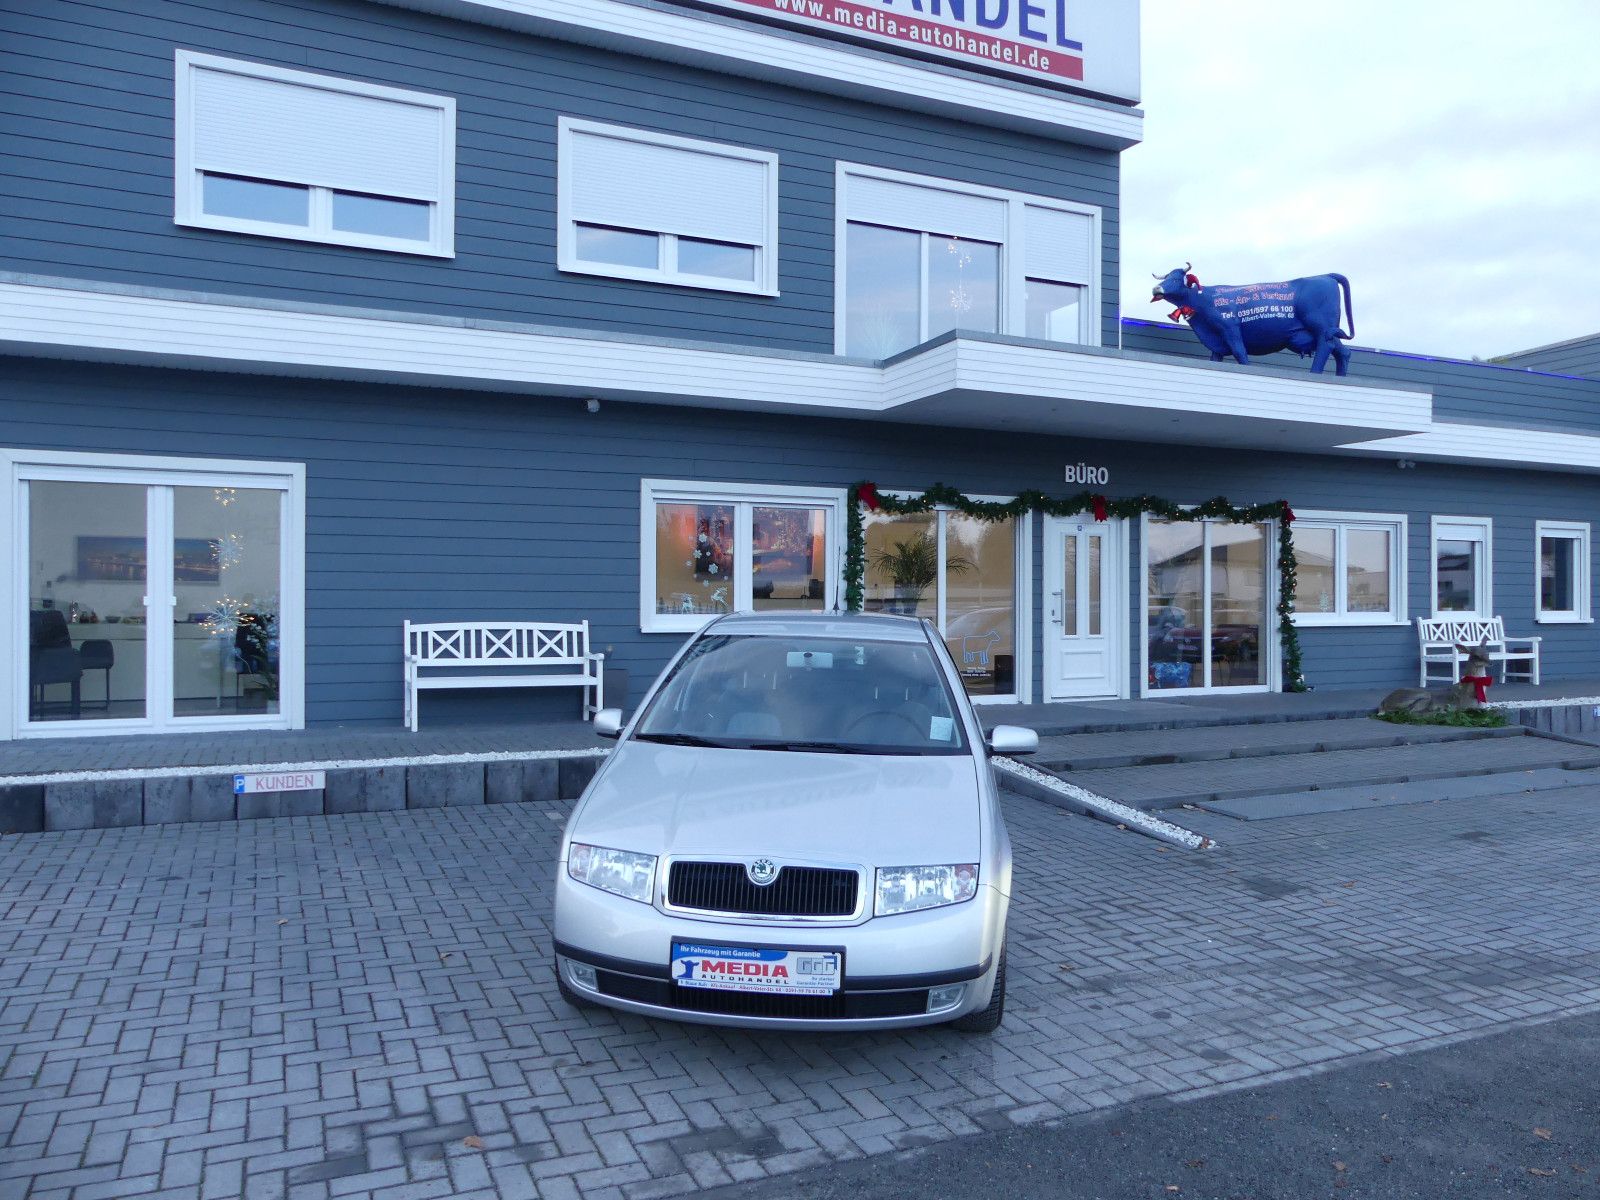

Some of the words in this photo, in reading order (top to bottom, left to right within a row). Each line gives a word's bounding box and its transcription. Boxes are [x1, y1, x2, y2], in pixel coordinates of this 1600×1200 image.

[883, 0, 1083, 51] DEL
[774, 0, 1050, 71] www.media-autohandel.de
[1281, 305, 1293, 313] 100
[1065, 462, 1109, 485] BÜRO
[236, 779, 244, 789] P
[255, 774, 314, 790] KUNDEN
[680, 945, 690, 953] Ihr
[690, 946, 720, 958] Fahrzeug
[721, 948, 731, 957] mit
[732, 950, 761, 959] Garantie
[701, 959, 789, 978] MEDIA
[701, 974, 790, 985] AUTOHANDEL
